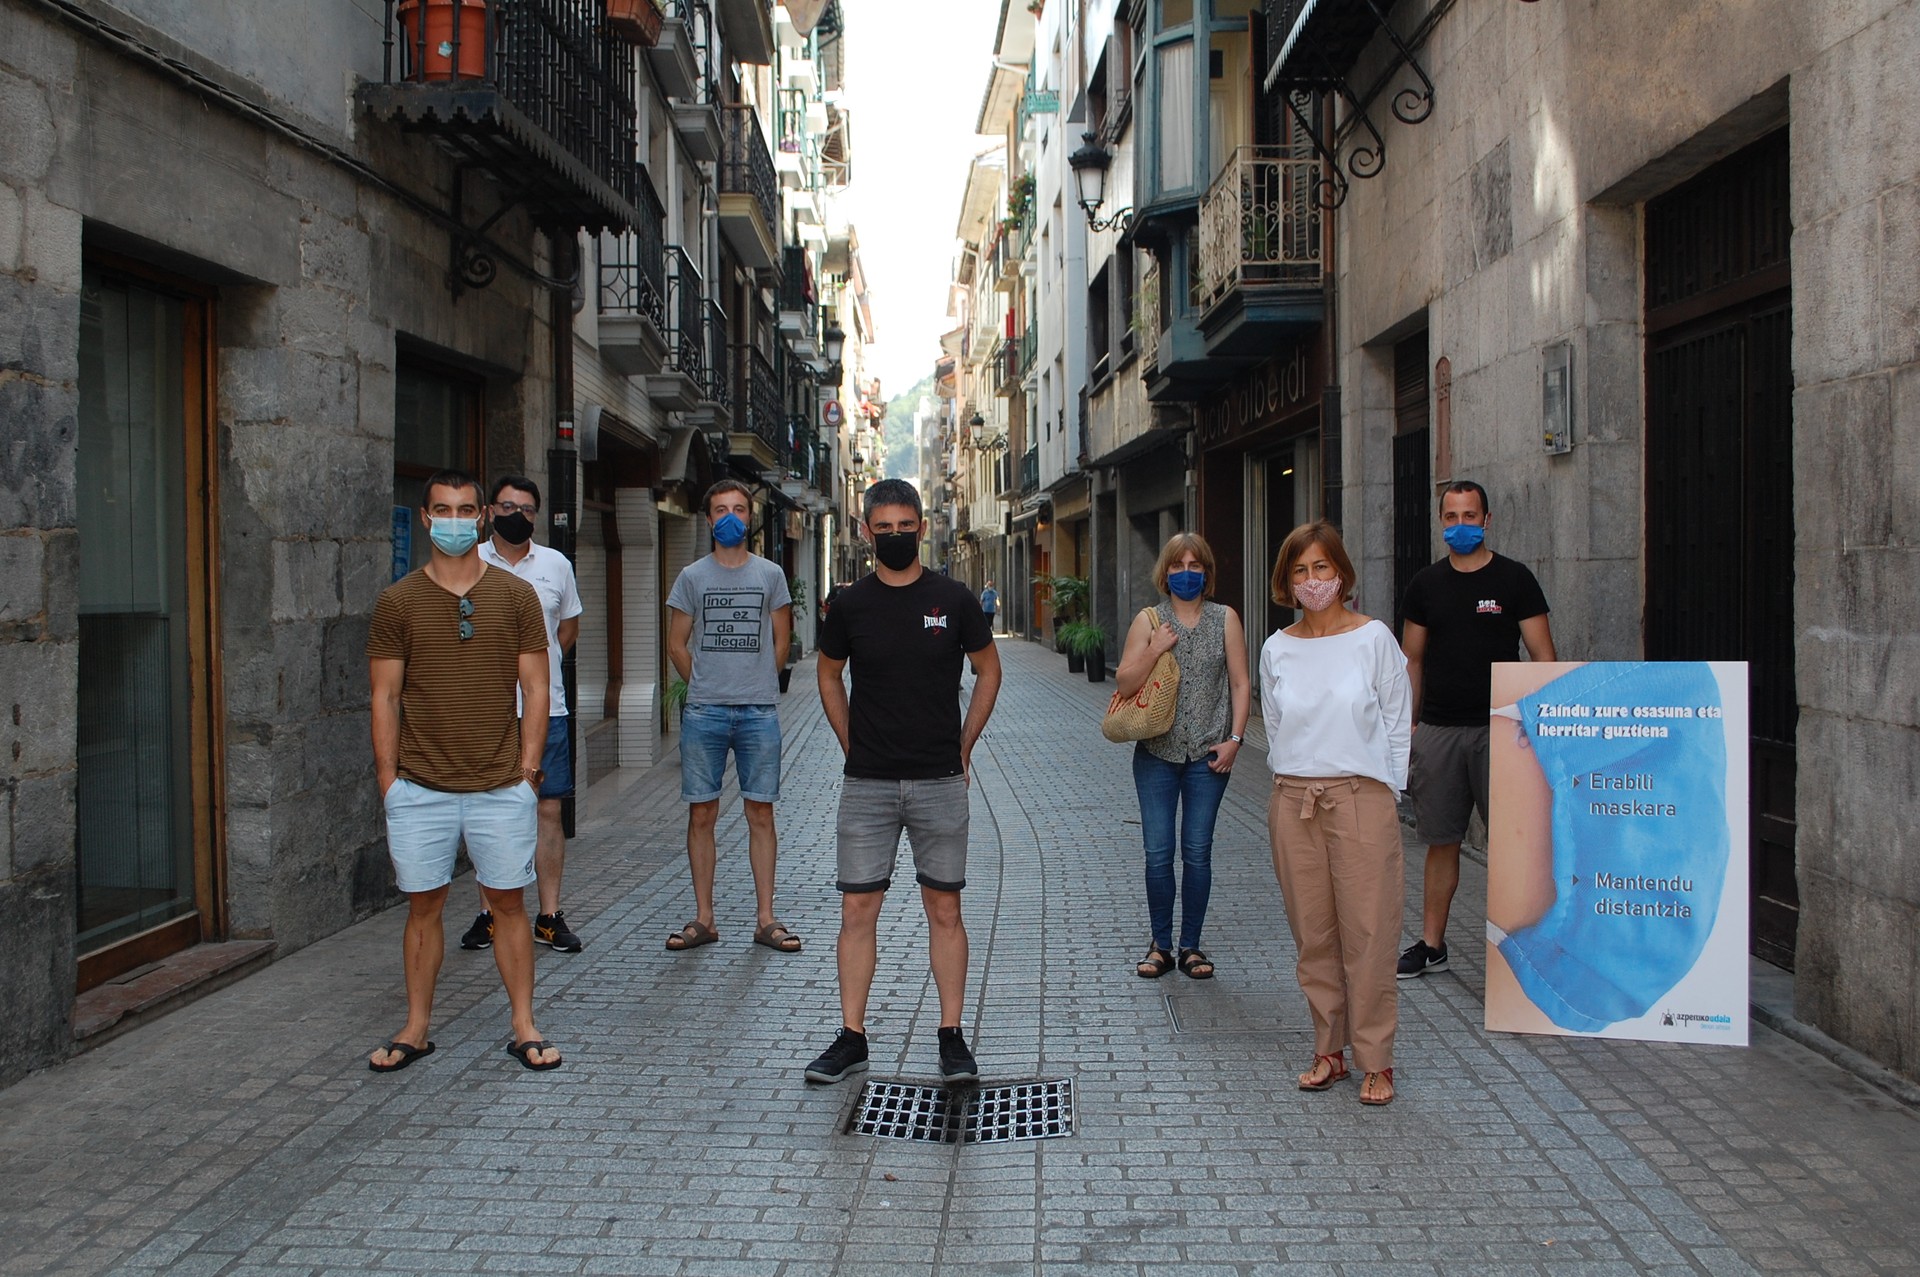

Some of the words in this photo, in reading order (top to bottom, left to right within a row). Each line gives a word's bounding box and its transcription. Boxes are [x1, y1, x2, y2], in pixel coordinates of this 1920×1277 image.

[1238, 343, 1306, 426] alberdi
[706, 596, 735, 606] inor
[732, 610, 749, 620] ez
[716, 622, 734, 633] da
[714, 635, 758, 649] ilegala
[1537, 703, 1590, 718] Zaindu
[1593, 705, 1629, 718] zure
[1632, 705, 1693, 719] osasuna
[1696, 704, 1722, 719] eta
[1537, 723, 1599, 738] herritar
[1602, 724, 1669, 740] guztiena
[1590, 772, 1654, 791] Erabili
[1589, 799, 1676, 817] maskara
[1595, 871, 1693, 893] Mantendu
[1594, 898, 1692, 919] distantzia
